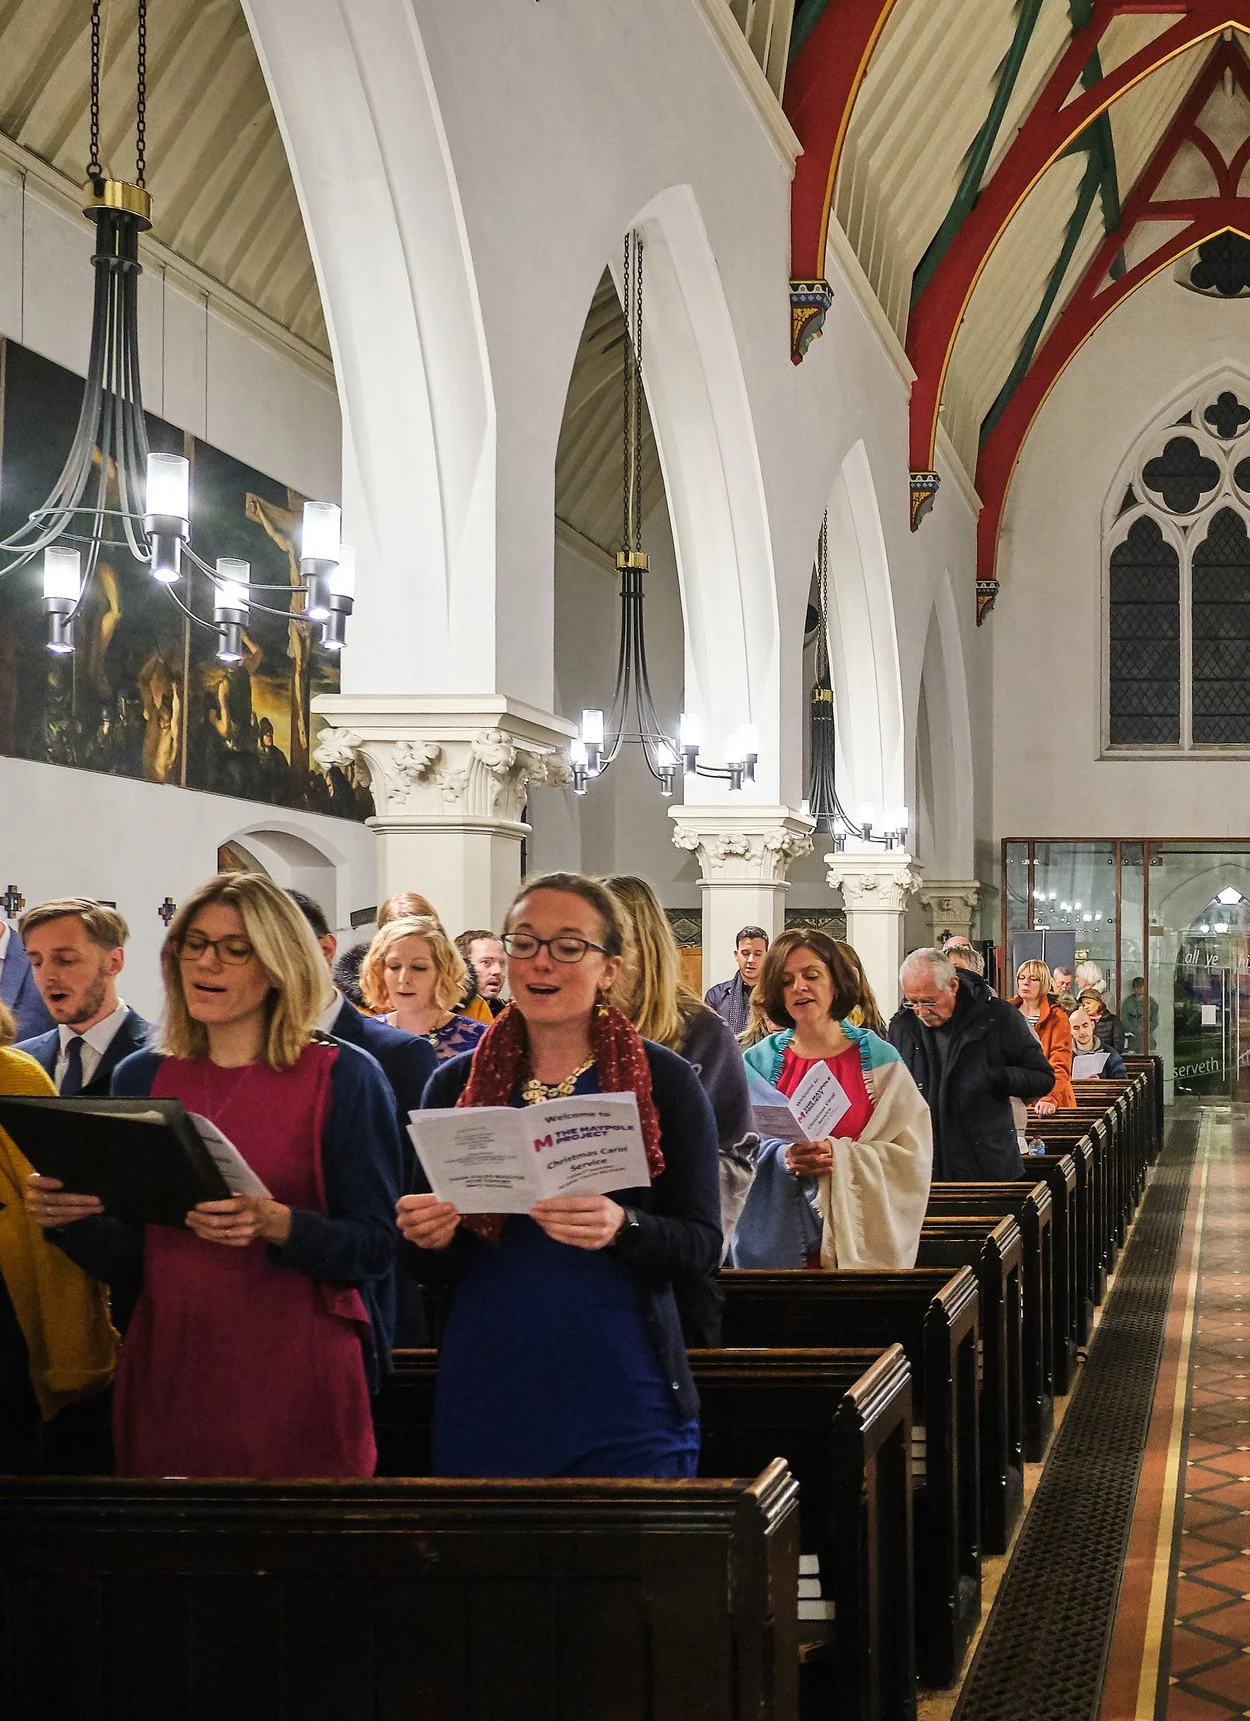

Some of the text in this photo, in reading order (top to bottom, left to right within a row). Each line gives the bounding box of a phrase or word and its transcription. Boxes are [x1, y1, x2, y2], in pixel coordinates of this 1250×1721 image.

[1184, 949, 1200, 964] all
[1204, 953, 1219, 969] ye
[797, 1111, 806, 1124] M
[812, 1076, 832, 1101] MAYPOLE
[544, 1111, 596, 1123] Welcome
[534, 1134, 554, 1153] M
[555, 1127, 578, 1138] THE
[555, 1131, 608, 1144] PROJECT
[547, 1146, 628, 1170] Christmas Carol
[570, 1158, 608, 1172] Service
